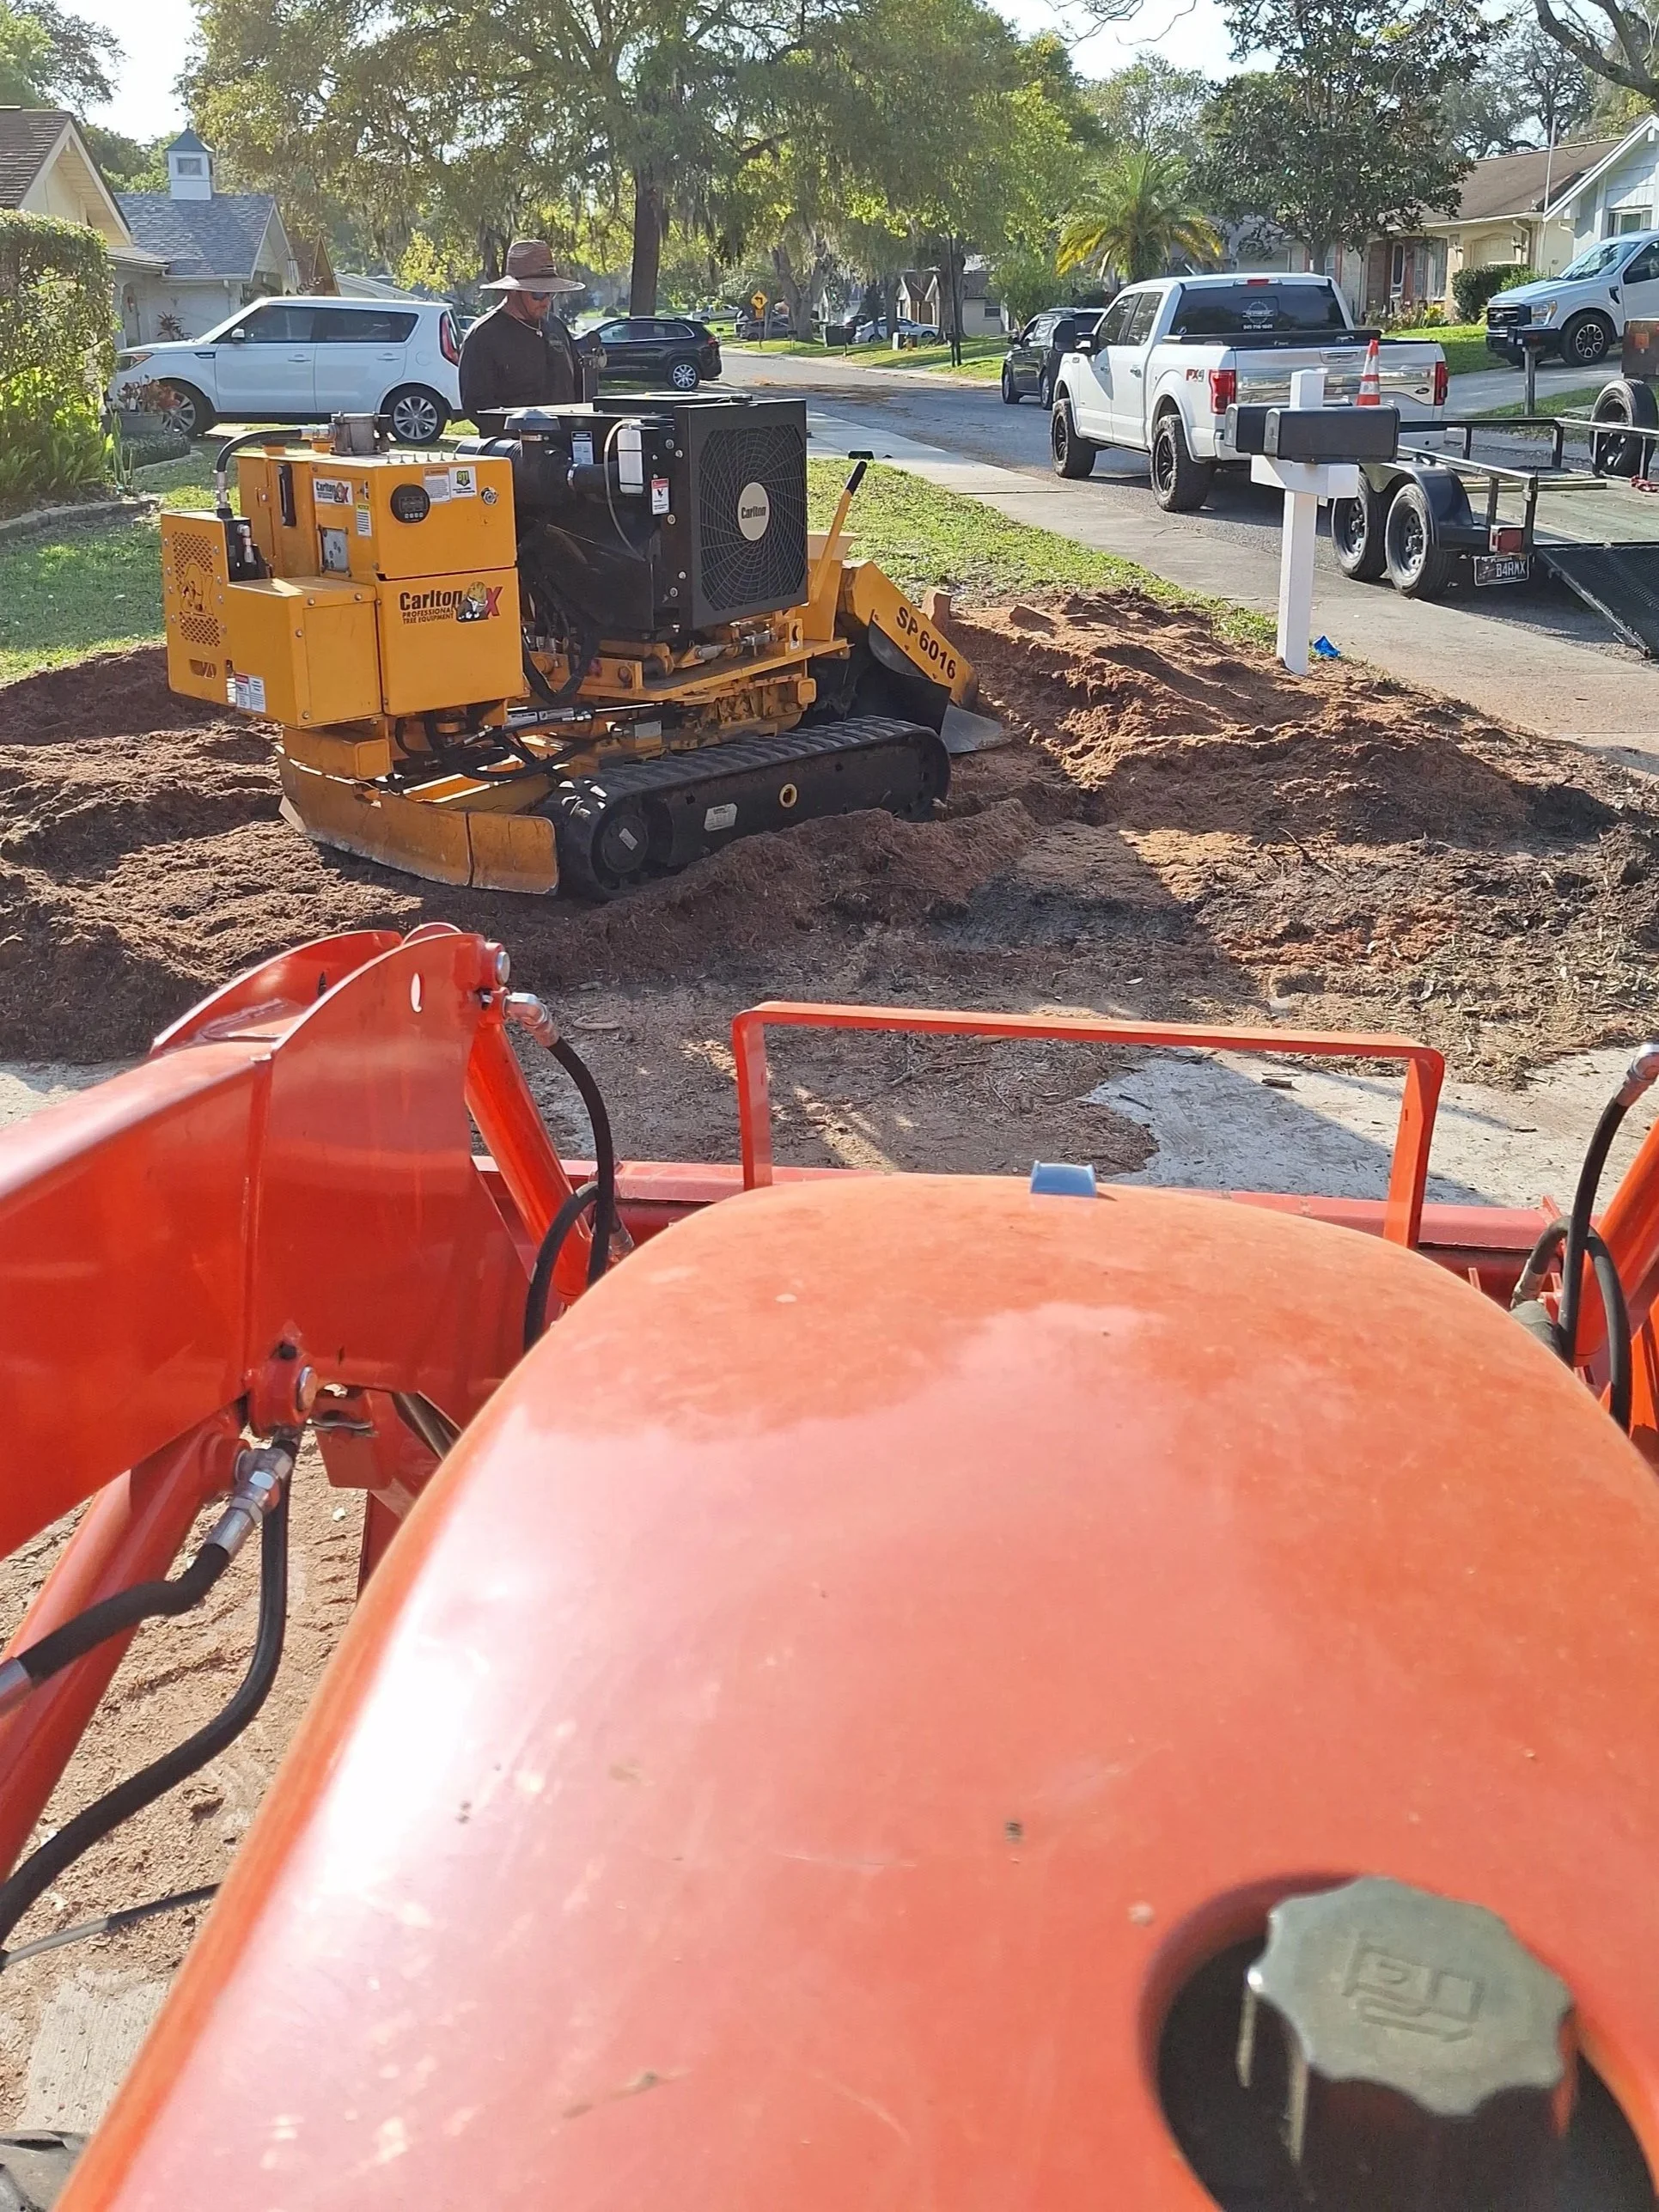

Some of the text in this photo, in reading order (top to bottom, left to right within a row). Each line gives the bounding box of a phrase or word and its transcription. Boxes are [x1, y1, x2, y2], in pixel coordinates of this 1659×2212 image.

[741, 506, 766, 519] Carlton
[400, 590, 463, 611] Carlton
[402, 606, 454, 619] PROFESSIONAL
[418, 612, 454, 623] EQUIPMENT
[896, 606, 956, 679] SP 6016
